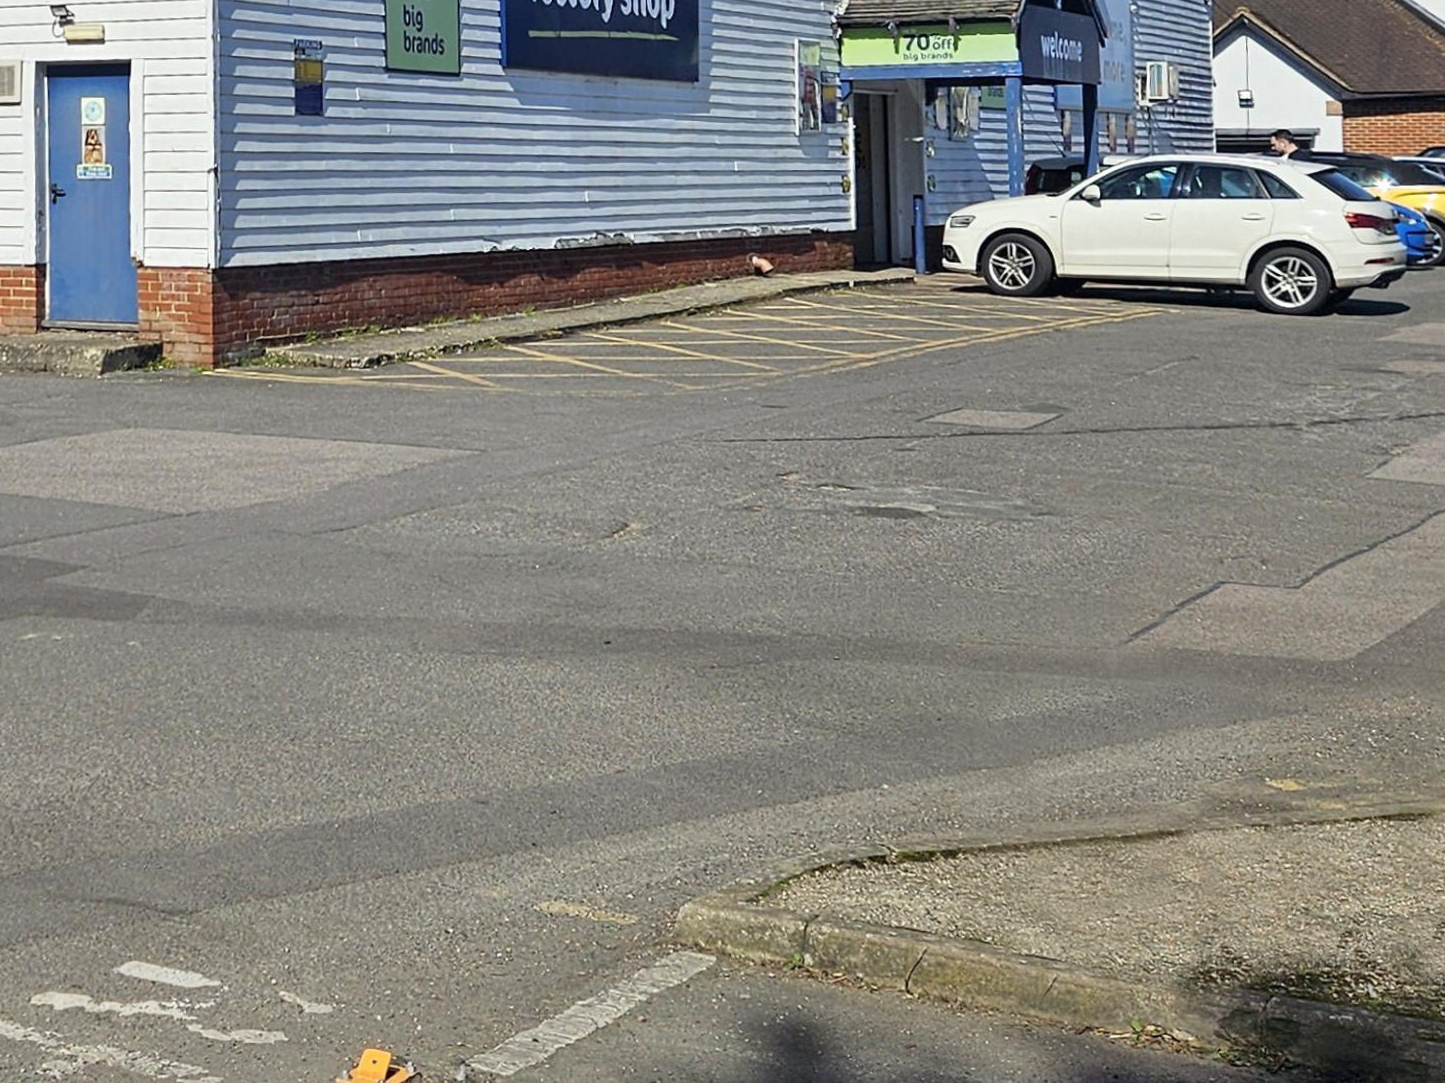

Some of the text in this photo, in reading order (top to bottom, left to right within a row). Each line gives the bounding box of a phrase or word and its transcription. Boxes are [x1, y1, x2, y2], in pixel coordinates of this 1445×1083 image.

[403, 3, 424, 33] big
[403, 29, 446, 56] brands
[932, 37, 954, 50] off
[1040, 30, 1083, 63] welcome
[903, 52, 954, 62] big brands
